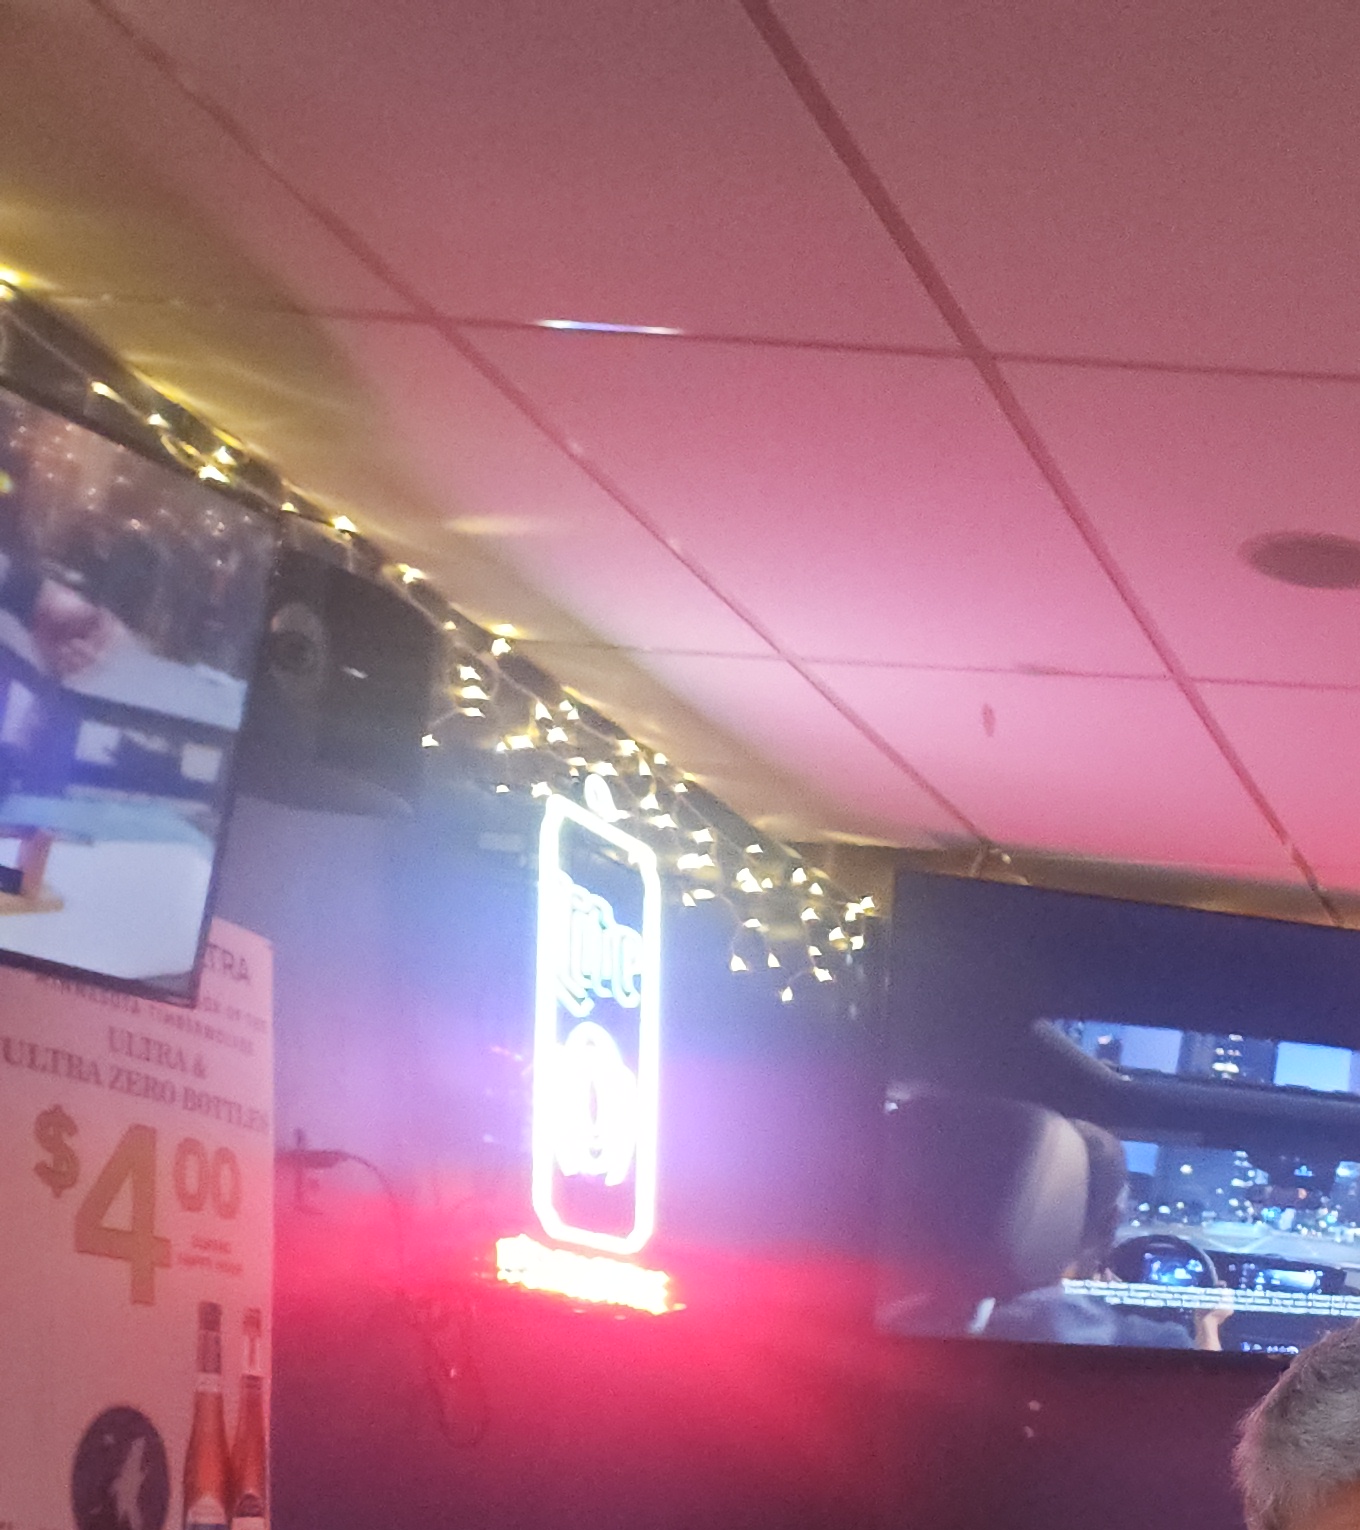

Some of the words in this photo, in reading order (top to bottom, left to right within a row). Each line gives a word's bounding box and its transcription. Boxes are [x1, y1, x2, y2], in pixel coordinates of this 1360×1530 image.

[1, 1036, 103, 1086] ULTRA
[108, 1066, 177, 1105] ZERO
[108, 1025, 188, 1074] ULTRA
